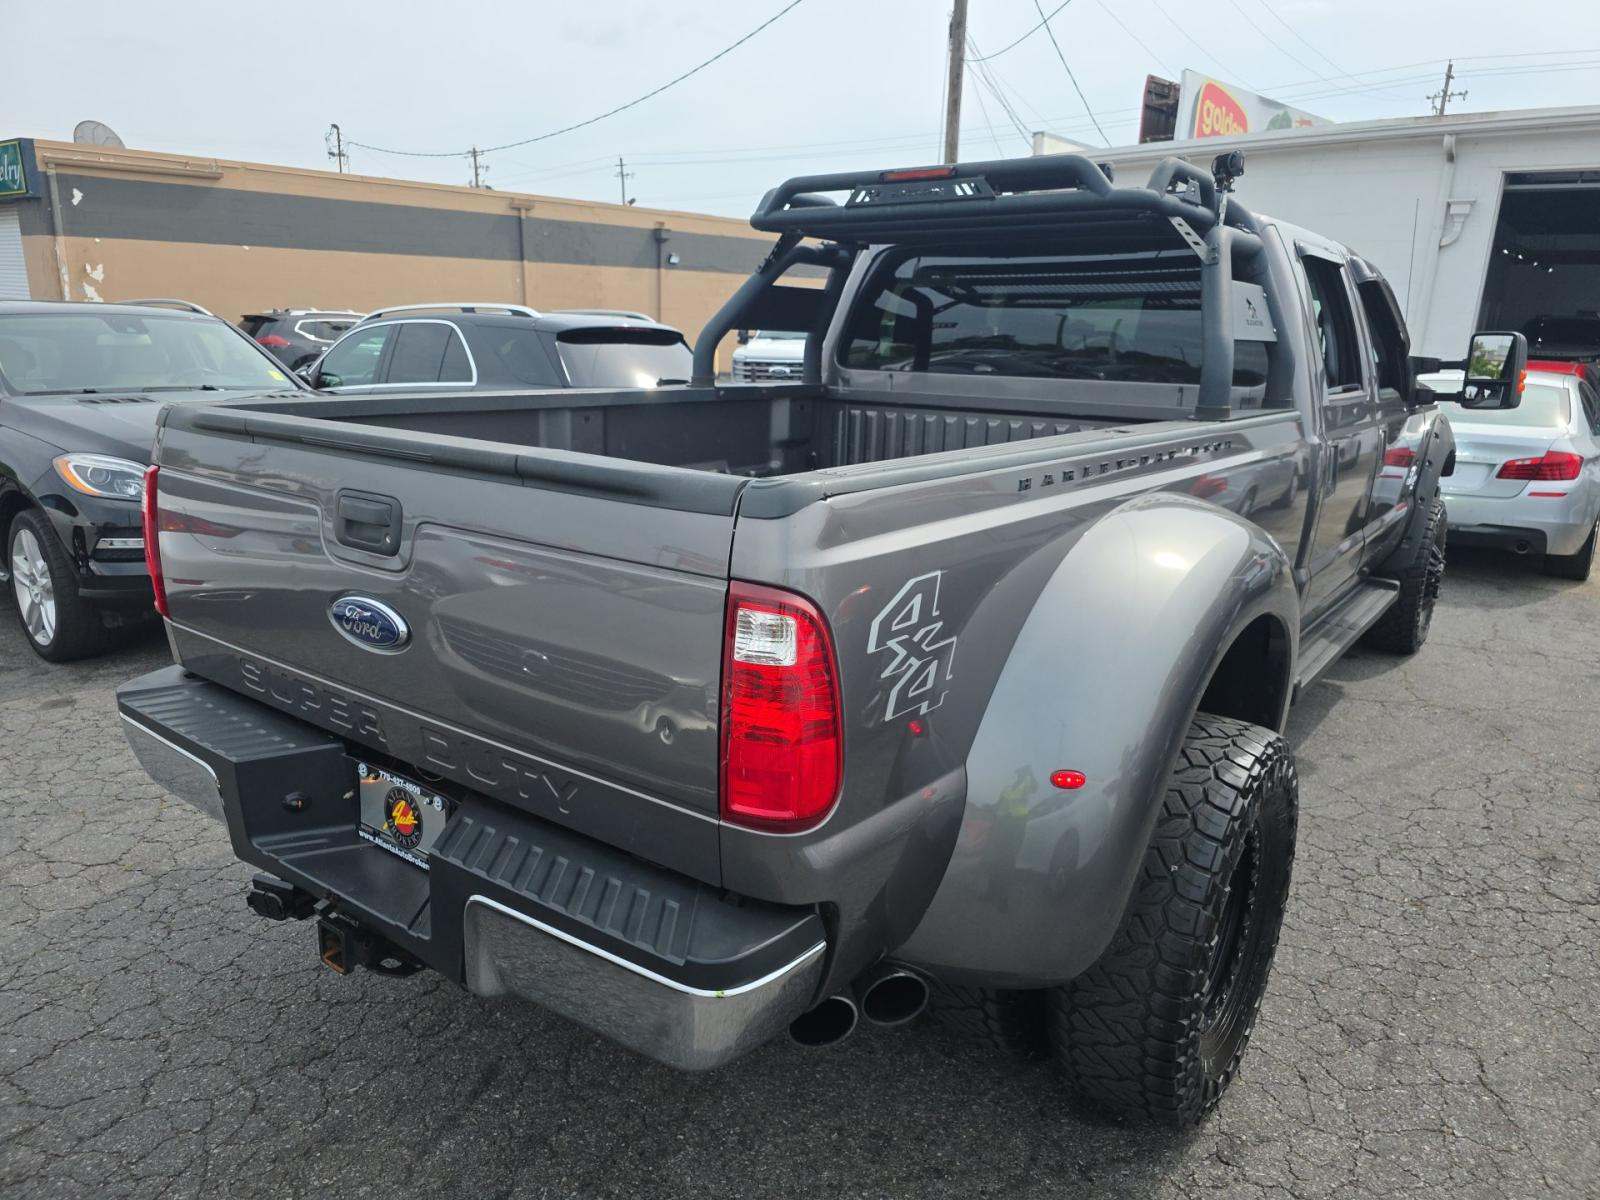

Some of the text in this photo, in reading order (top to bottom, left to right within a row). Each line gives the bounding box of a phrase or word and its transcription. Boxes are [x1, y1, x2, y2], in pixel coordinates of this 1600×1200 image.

[342, 605, 382, 639] Ford
[239, 657, 579, 815] SUPER DUTY
